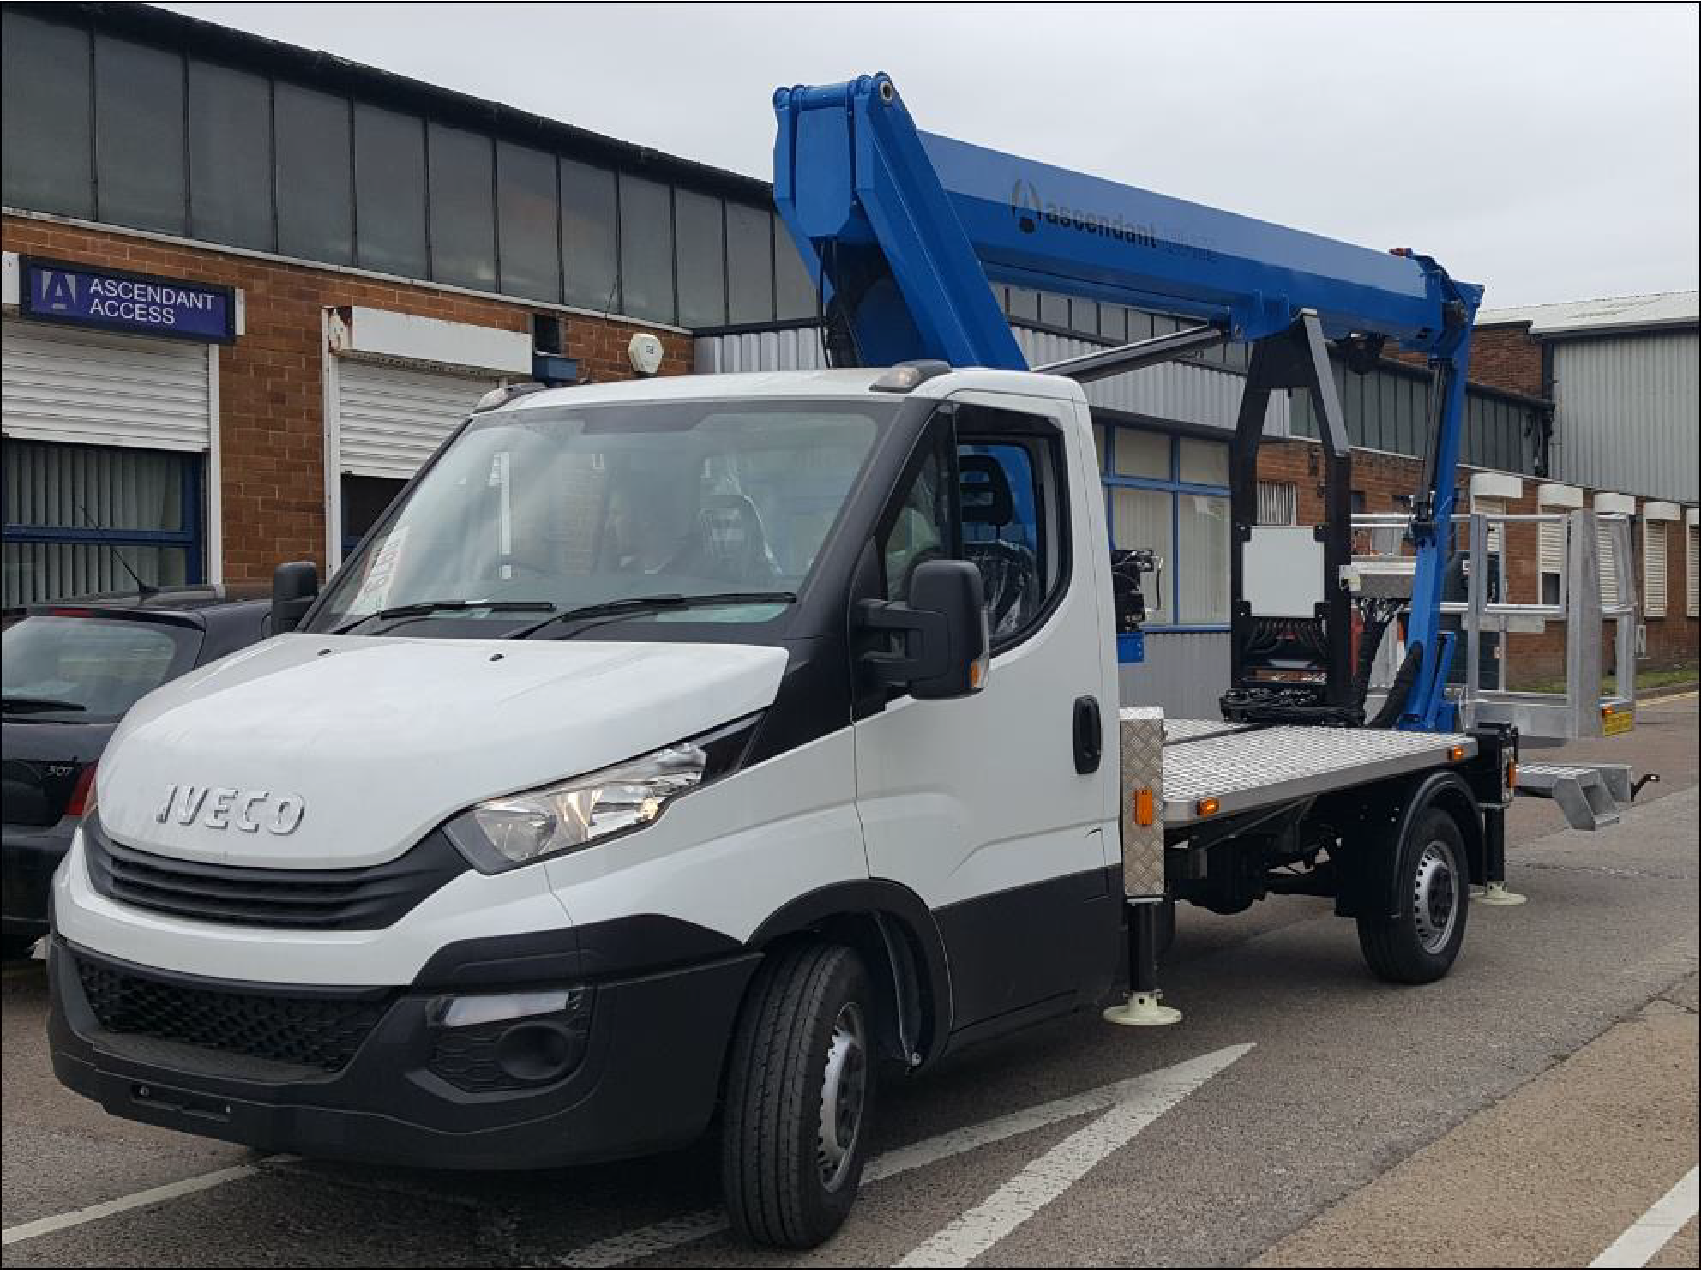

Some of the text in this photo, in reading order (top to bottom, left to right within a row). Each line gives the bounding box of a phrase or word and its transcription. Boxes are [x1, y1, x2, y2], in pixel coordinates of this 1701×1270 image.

[1047, 202, 1157, 249] ascendant
[89, 278, 215, 310] ASCENDANT
[89, 299, 176, 325] ACCESS
[155, 783, 305, 836] IVECO
